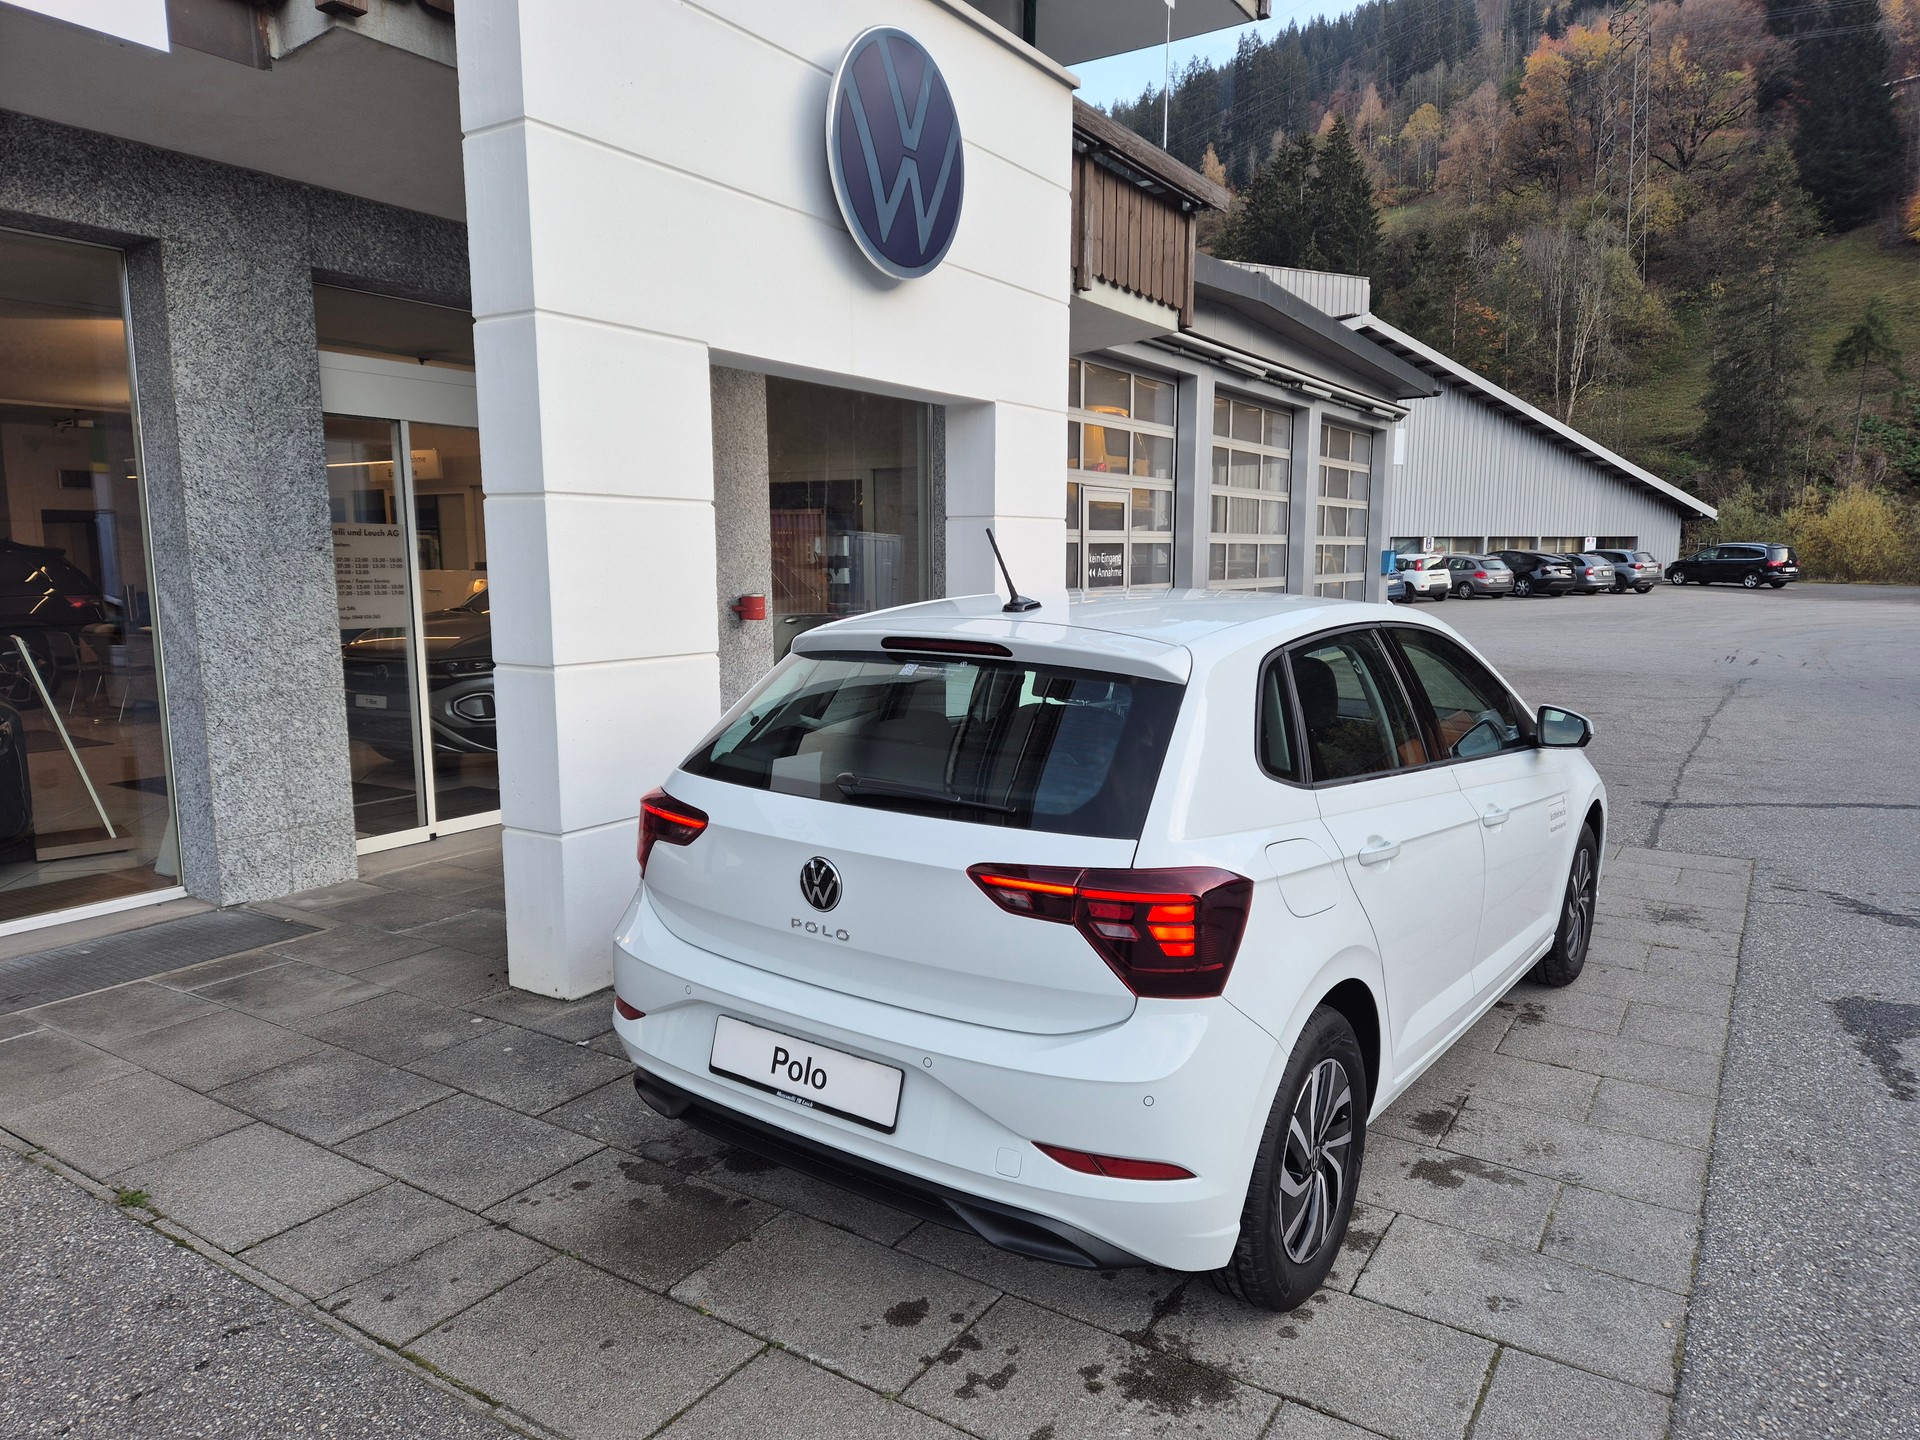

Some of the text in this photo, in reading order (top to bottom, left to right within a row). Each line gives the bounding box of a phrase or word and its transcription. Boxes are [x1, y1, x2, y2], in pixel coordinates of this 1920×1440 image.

[364, 529, 385, 537] Leuch
[1101, 552, 1122, 565] Eingang
[1097, 567, 1122, 577] Annahme
[791, 917, 850, 941] POLO
[771, 1046, 827, 1090] Polo
